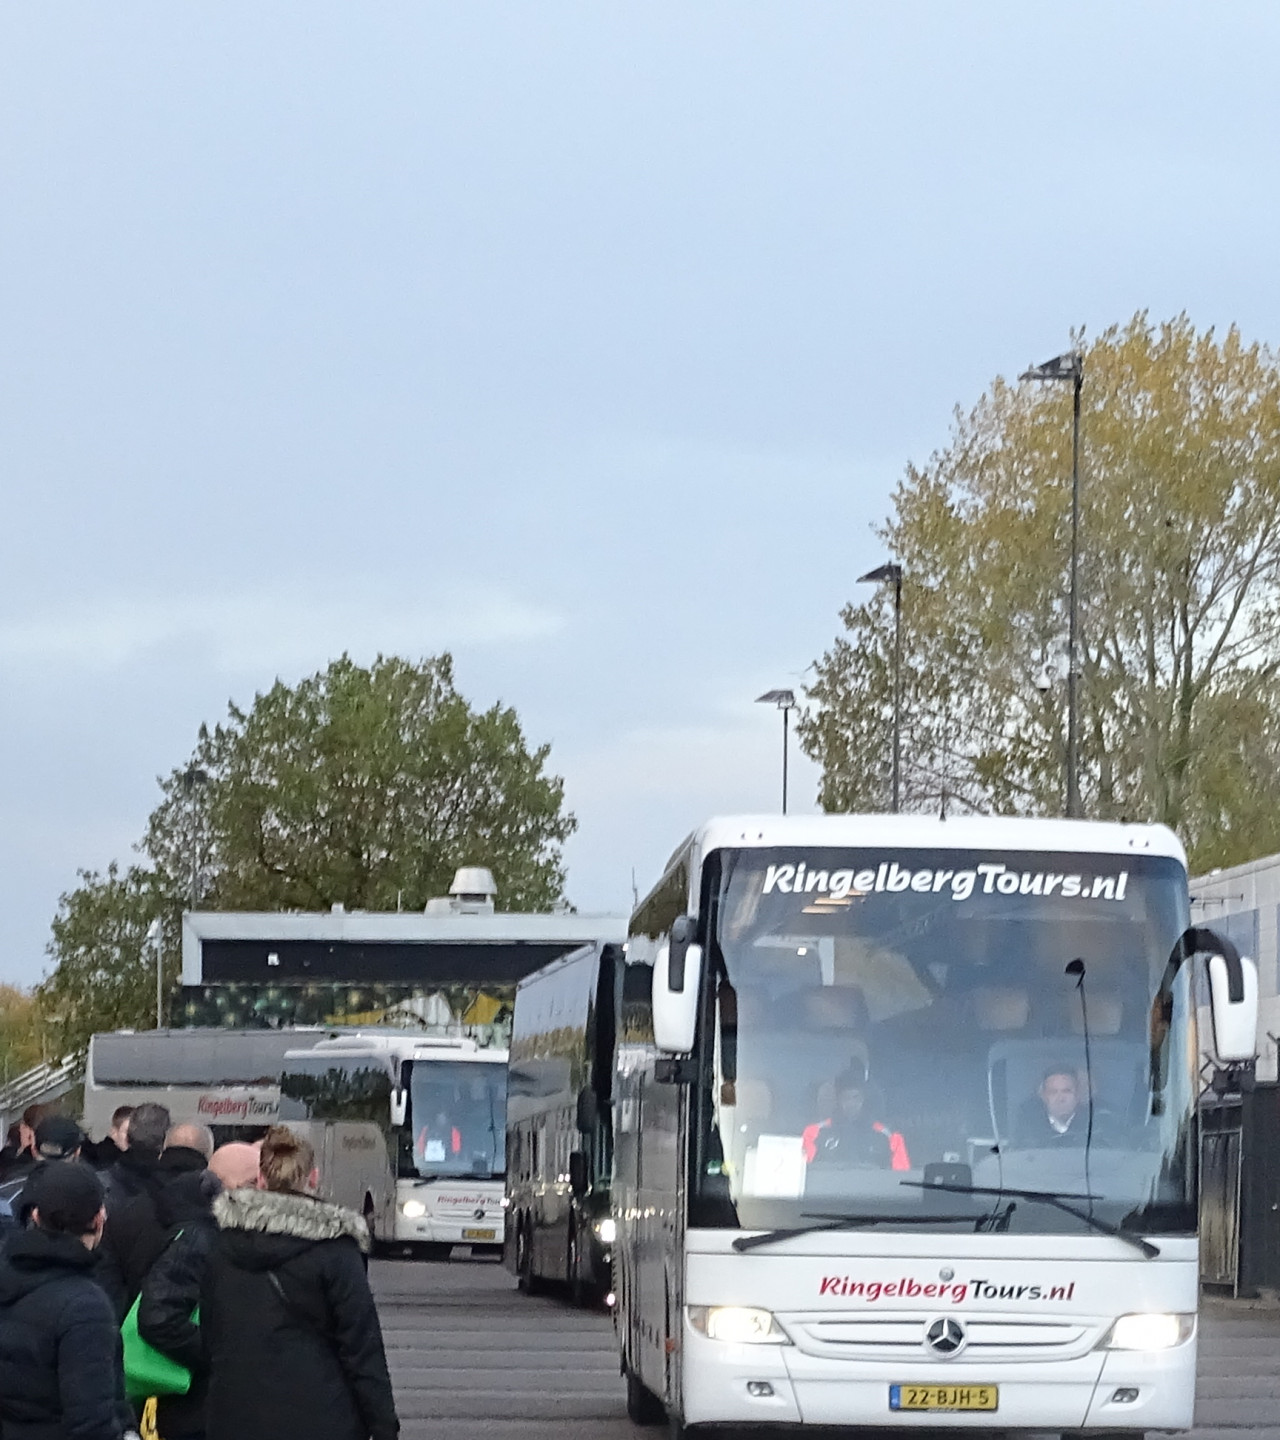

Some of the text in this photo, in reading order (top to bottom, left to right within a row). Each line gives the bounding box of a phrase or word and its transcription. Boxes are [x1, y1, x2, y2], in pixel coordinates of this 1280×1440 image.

[761, 862, 1129, 901] RingelbergTours.nl
[818, 1274, 1076, 1304] RingelbergTours.nl
[907, 1389, 990, 1406] 22-BJH-5
